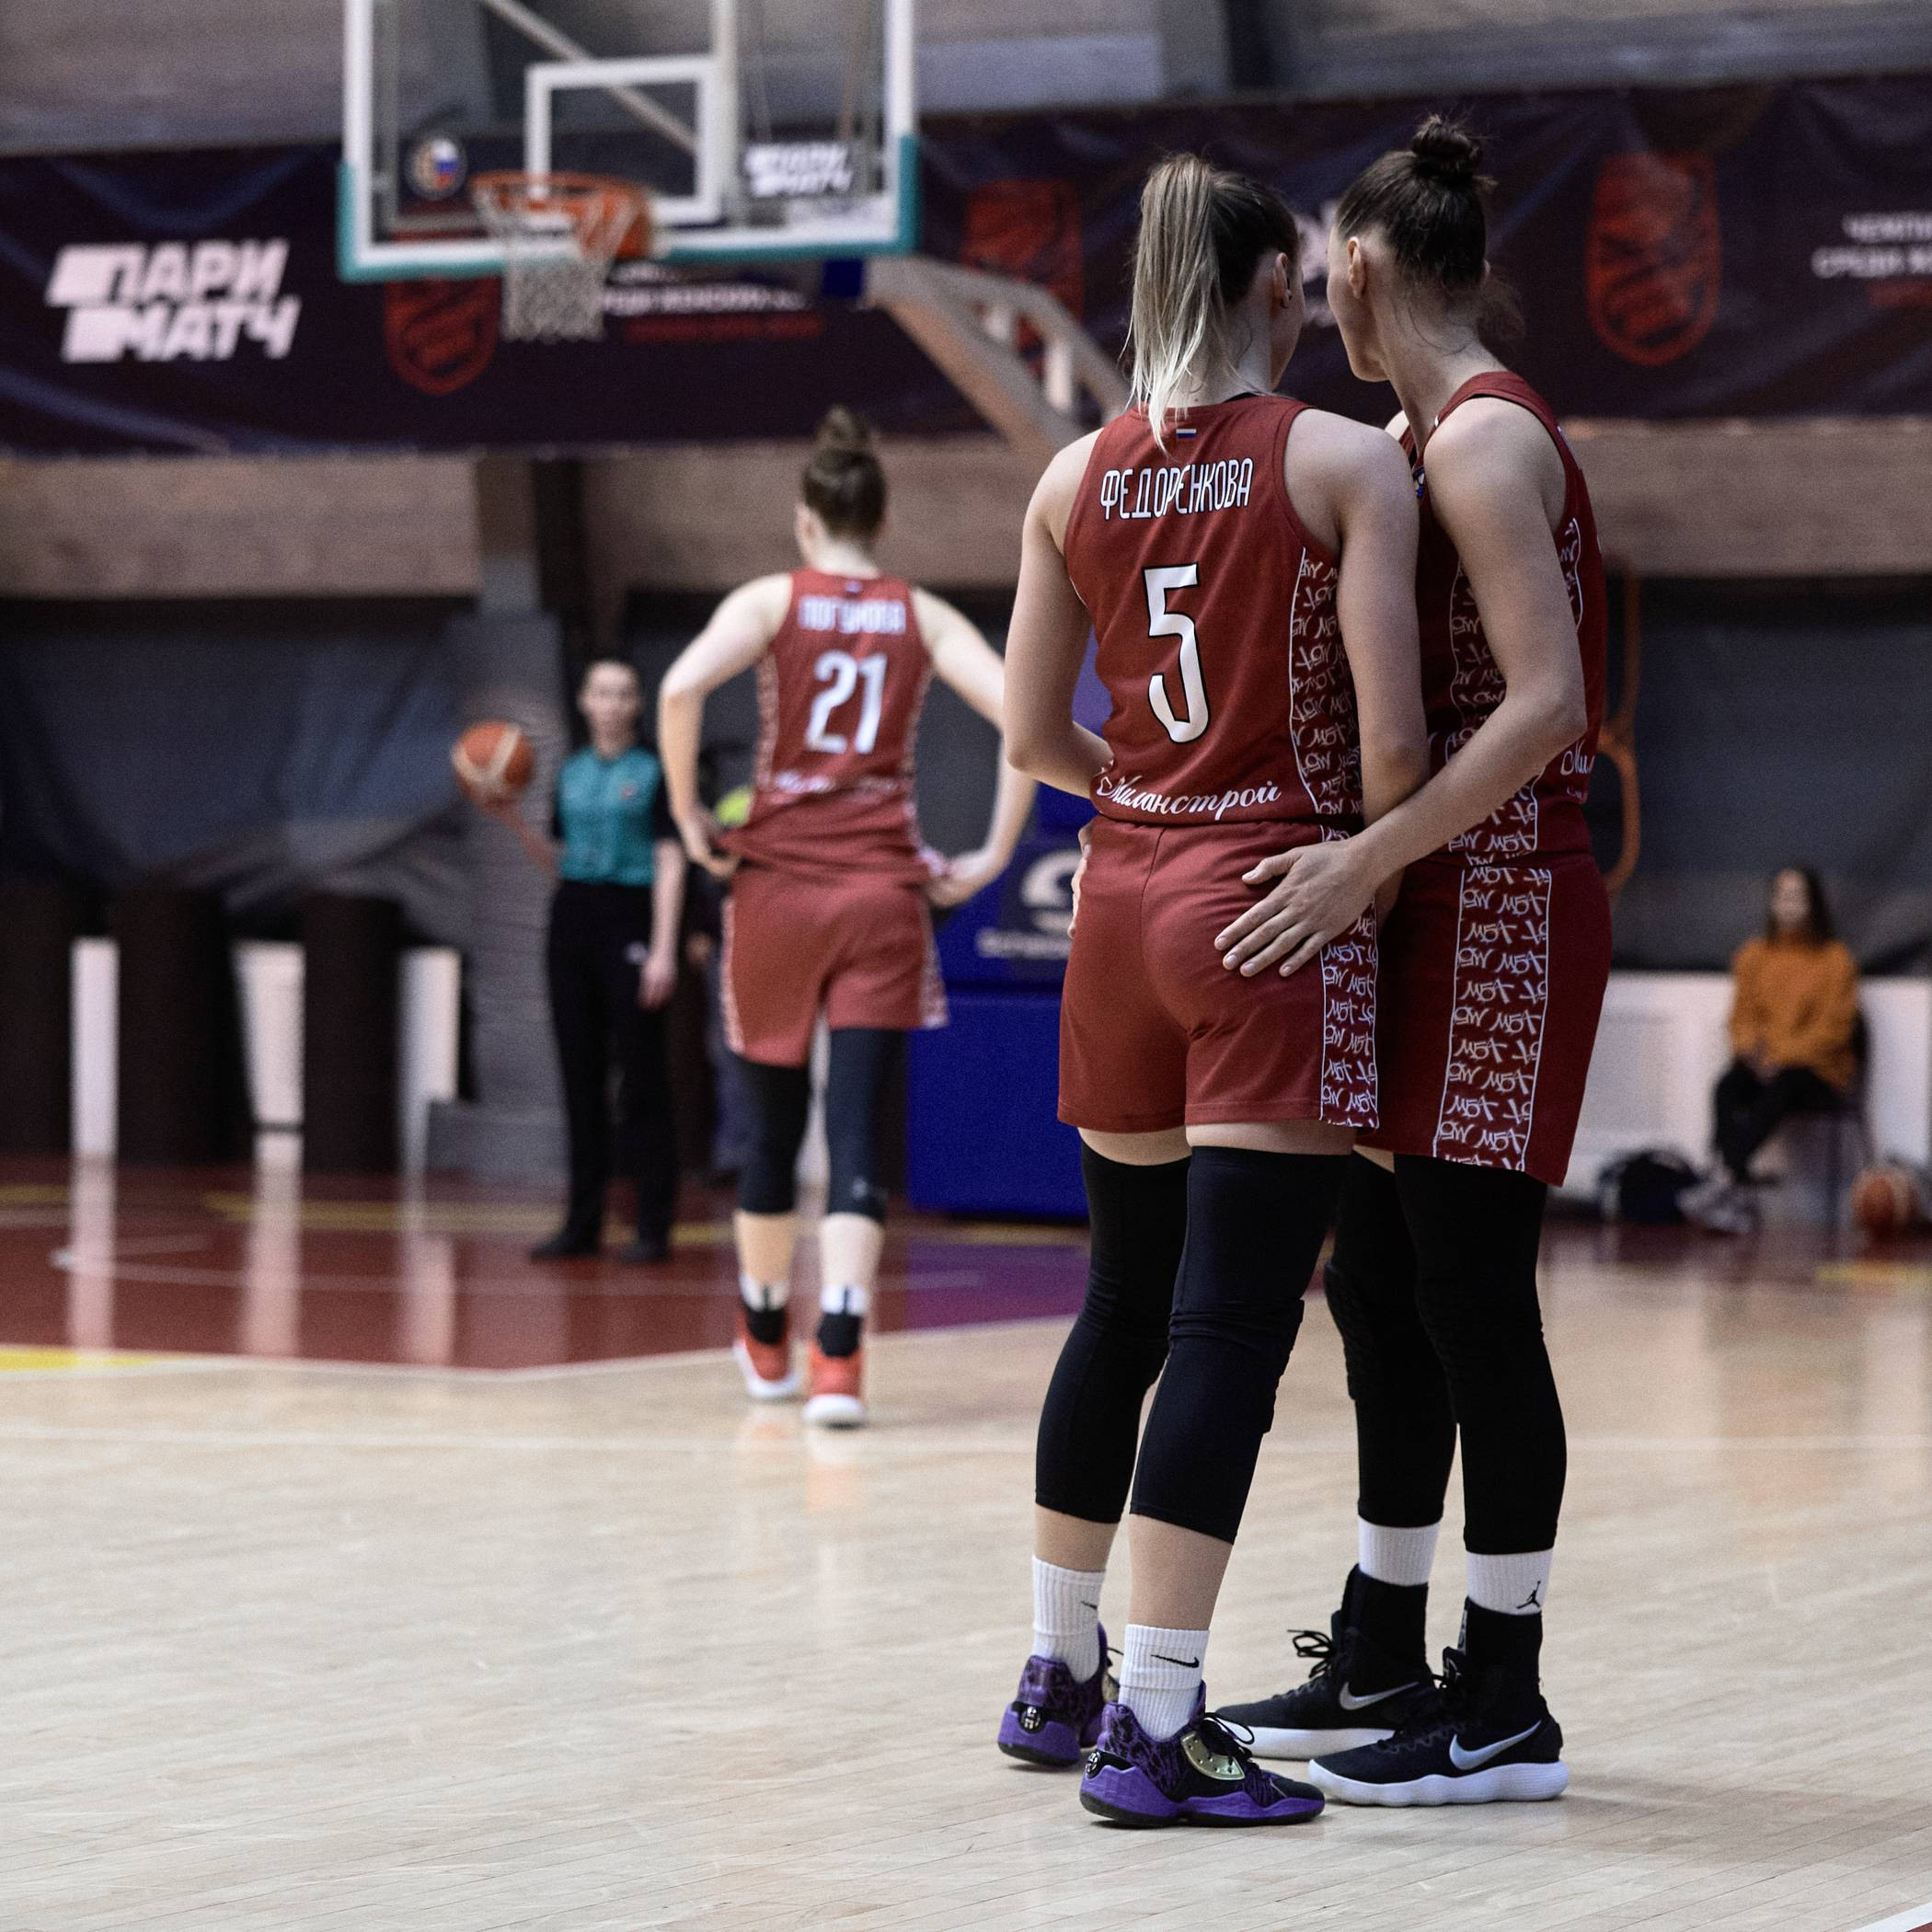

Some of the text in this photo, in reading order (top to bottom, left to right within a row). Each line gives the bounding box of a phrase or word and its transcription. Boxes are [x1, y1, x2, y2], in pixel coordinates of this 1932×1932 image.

[46, 241, 289, 305] ПАРИ
[61, 296, 301, 362] МАТЧ
[1100, 457, 1254, 521] ФЕДОРЕНКОВА
[1144, 563, 1211, 744] 5
[804, 650, 888, 755] 21
[1096, 775, 1282, 821] Миланстрой
